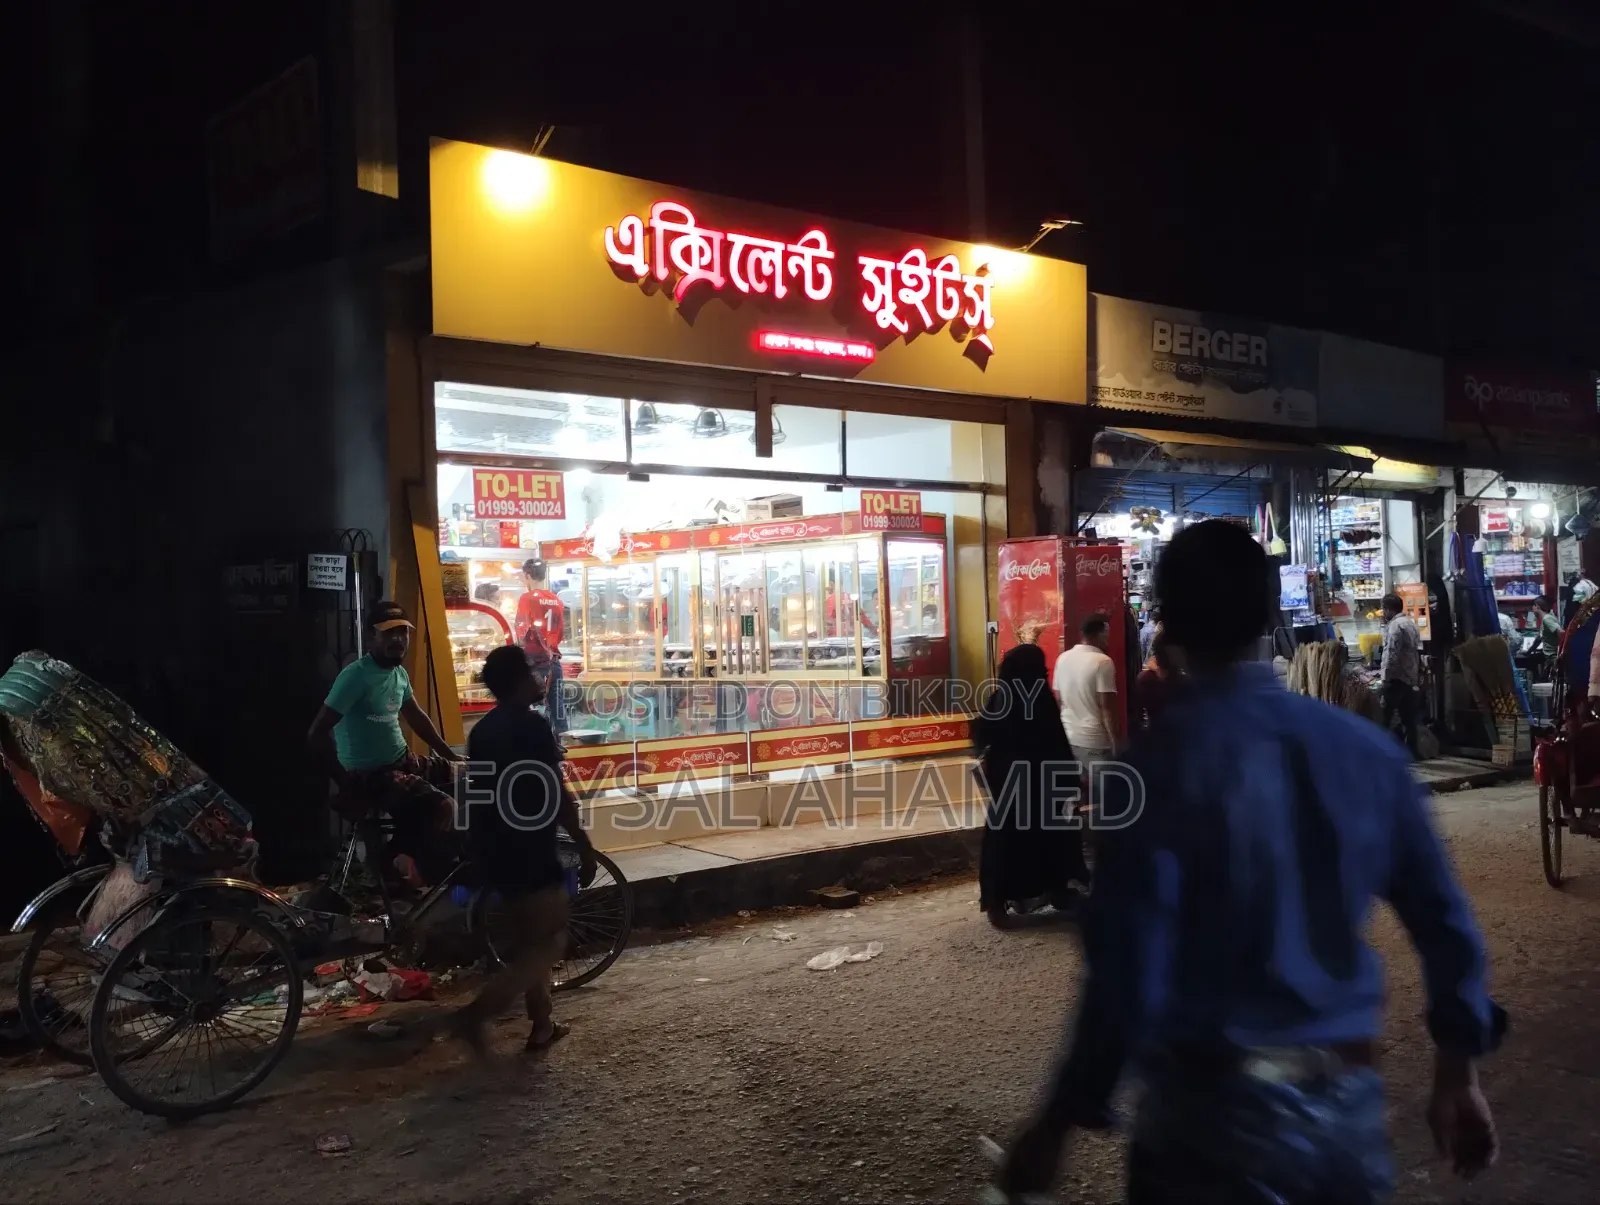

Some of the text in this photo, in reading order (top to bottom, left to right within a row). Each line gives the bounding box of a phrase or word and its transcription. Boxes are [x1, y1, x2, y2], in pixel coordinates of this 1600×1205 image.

[1152, 320, 1267, 366] BERGER
[475, 472, 561, 499] TO-LET
[477, 499, 562, 516] 01999-300024
[862, 493, 920, 514] TO-LET
[544, 608, 553, 632] 1
